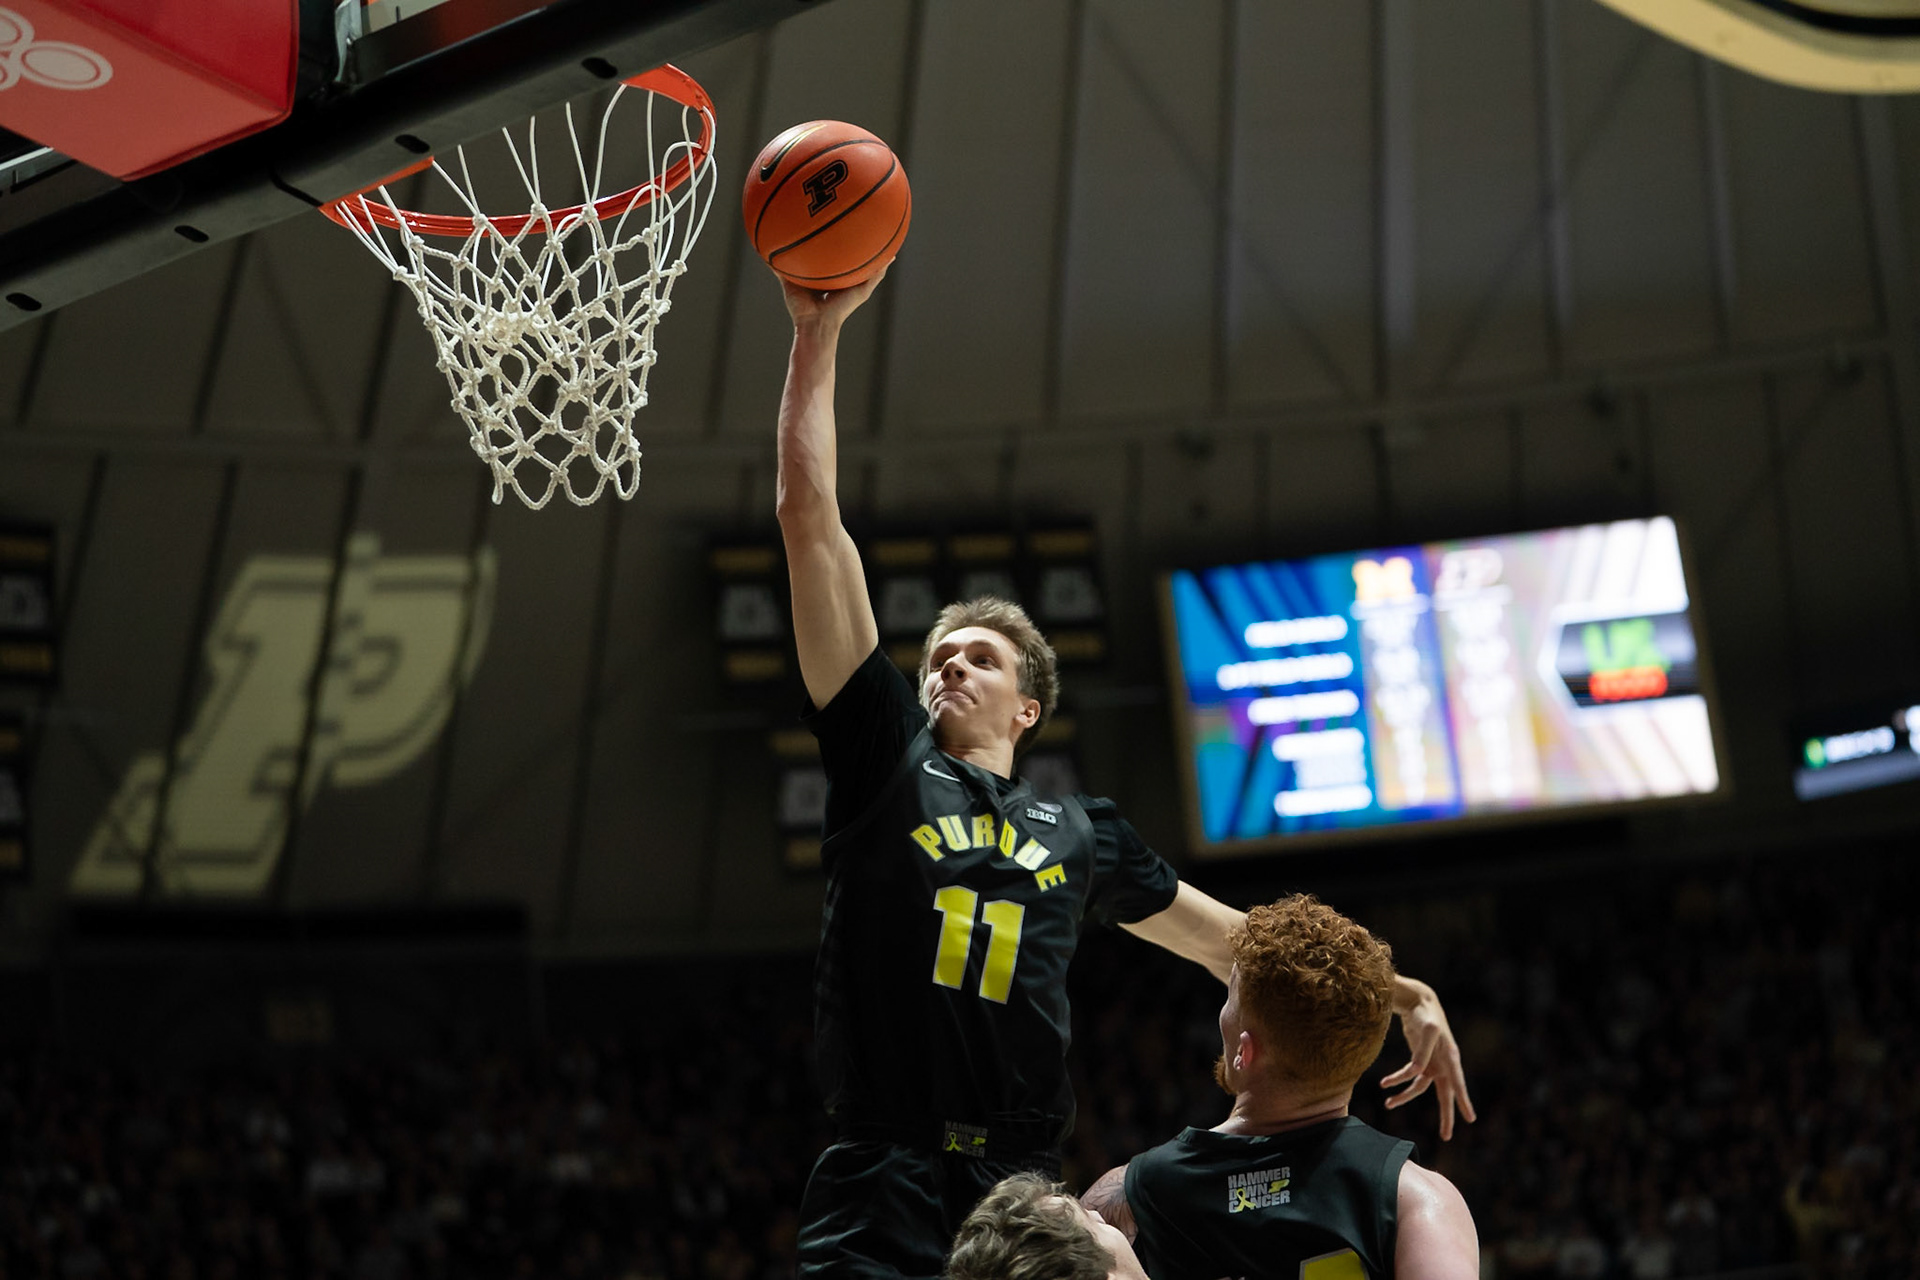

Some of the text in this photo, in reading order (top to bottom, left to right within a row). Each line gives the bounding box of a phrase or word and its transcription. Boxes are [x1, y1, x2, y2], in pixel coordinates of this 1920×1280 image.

[802, 159, 848, 217] P
[909, 813, 1068, 893] PURDUE
[932, 885, 1025, 1005] 11
[1227, 1166, 1291, 1188] HAMMER
